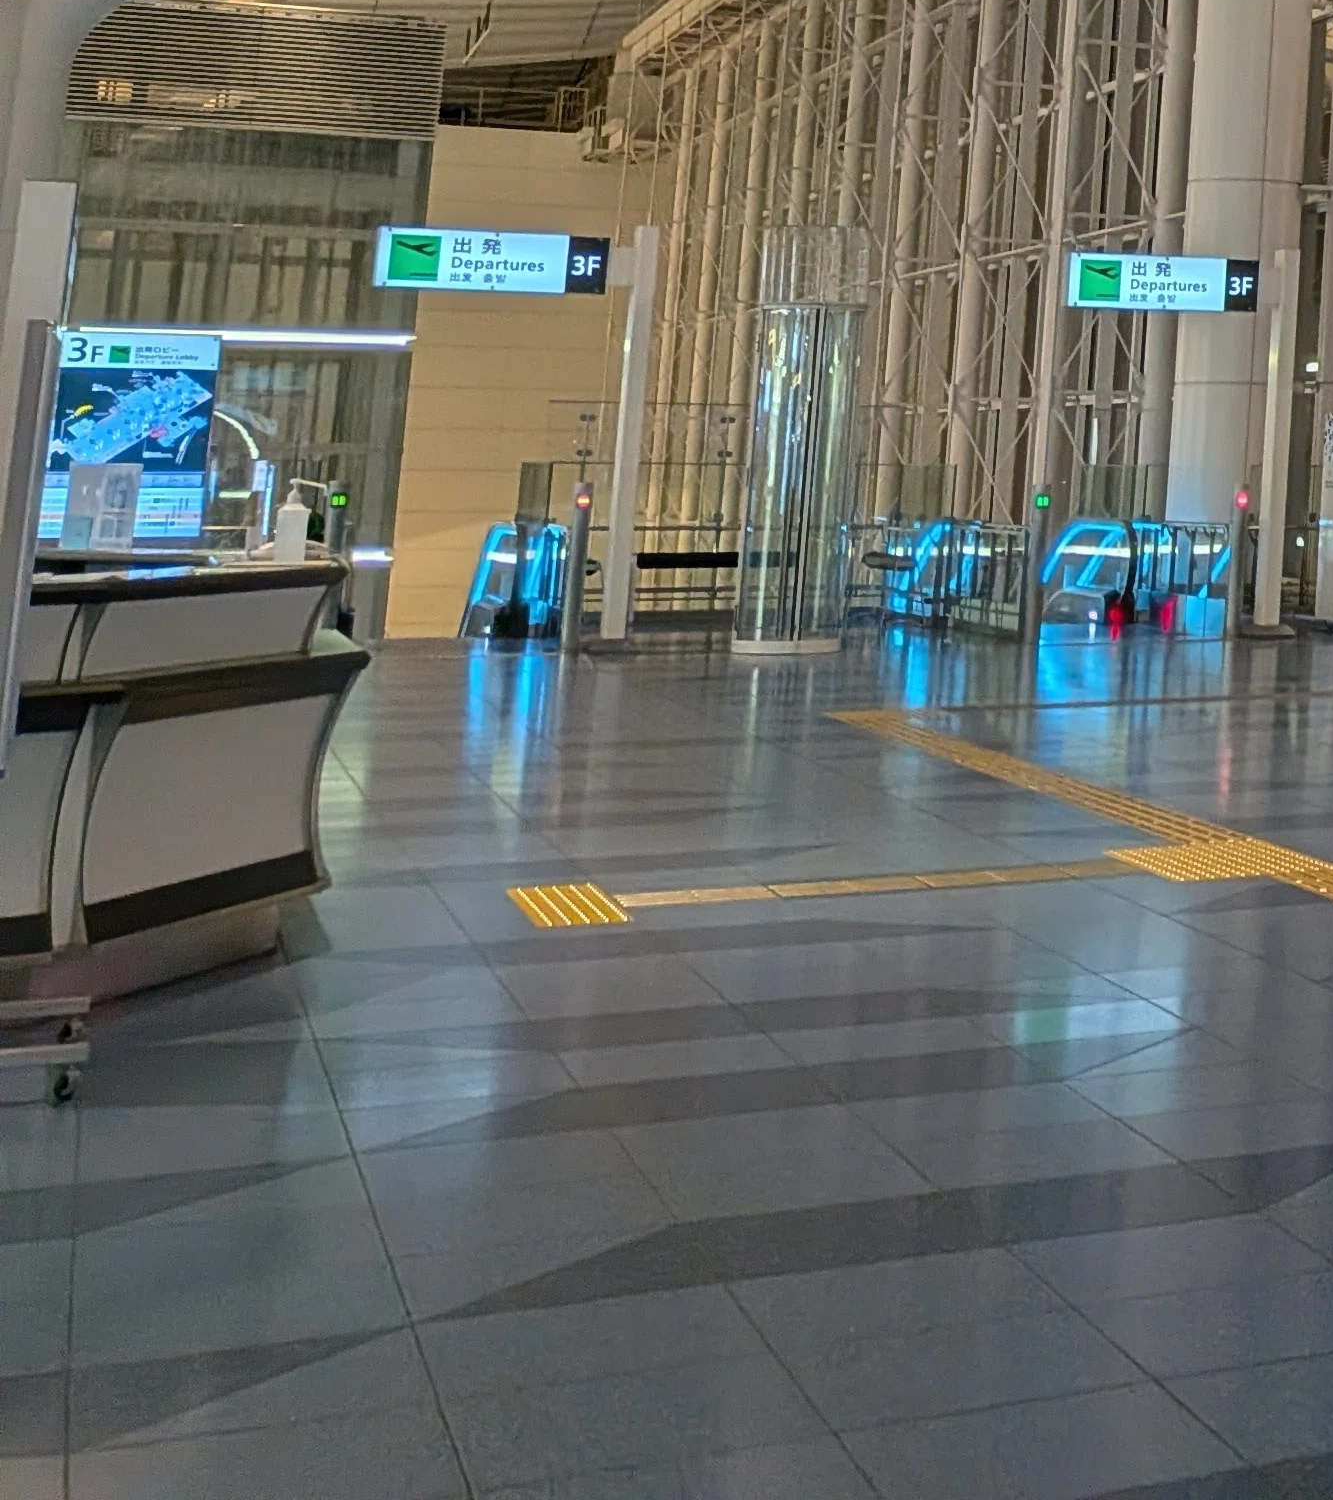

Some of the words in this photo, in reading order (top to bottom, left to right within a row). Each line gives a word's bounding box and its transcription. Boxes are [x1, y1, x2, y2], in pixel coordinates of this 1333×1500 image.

[451, 256, 545, 273] Departures
[571, 255, 601, 277] 3F
[1130, 279, 1207, 293] Departures
[1228, 276, 1254, 296] 3F
